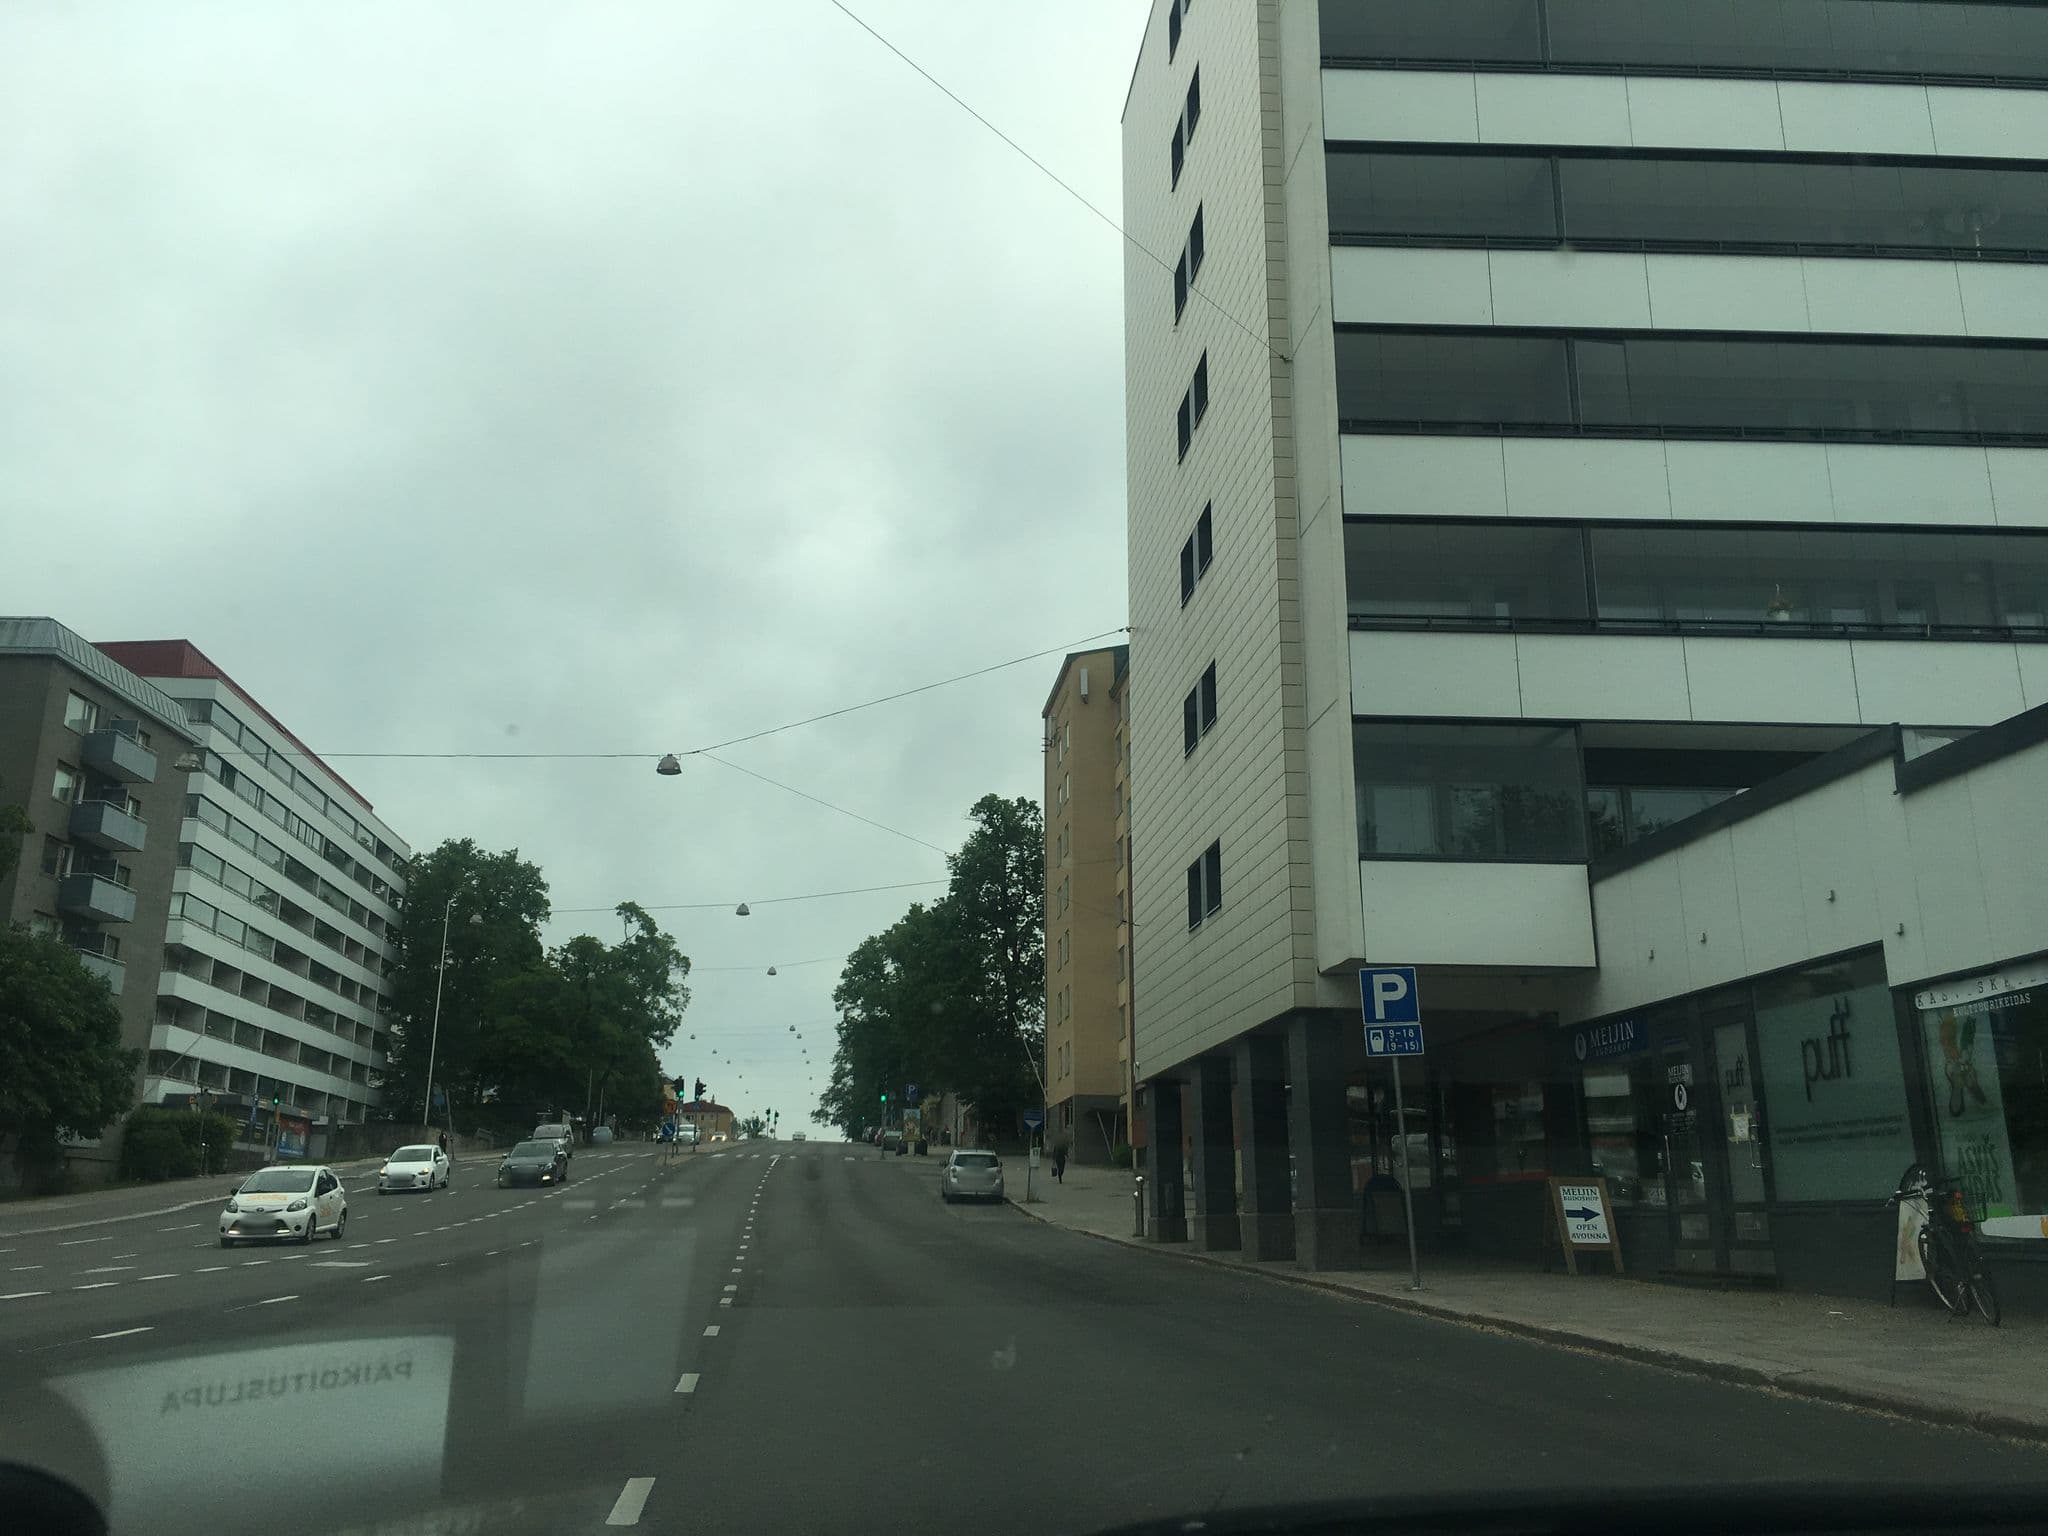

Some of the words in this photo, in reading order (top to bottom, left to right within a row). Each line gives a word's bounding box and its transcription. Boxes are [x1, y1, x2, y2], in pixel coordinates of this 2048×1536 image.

[1372, 973, 1407, 1019] P
[1389, 1028, 1415, 1039] 9-18
[1590, 1020, 1634, 1048] MEIJIN
[1387, 1040, 1419, 1052] (9-15)
[1800, 997, 1851, 1102] puff
[1562, 1188, 1597, 1196] MEIJIN
[1576, 1223, 1598, 1231] OPEN
[1571, 1232, 1608, 1240] AVOINNA
